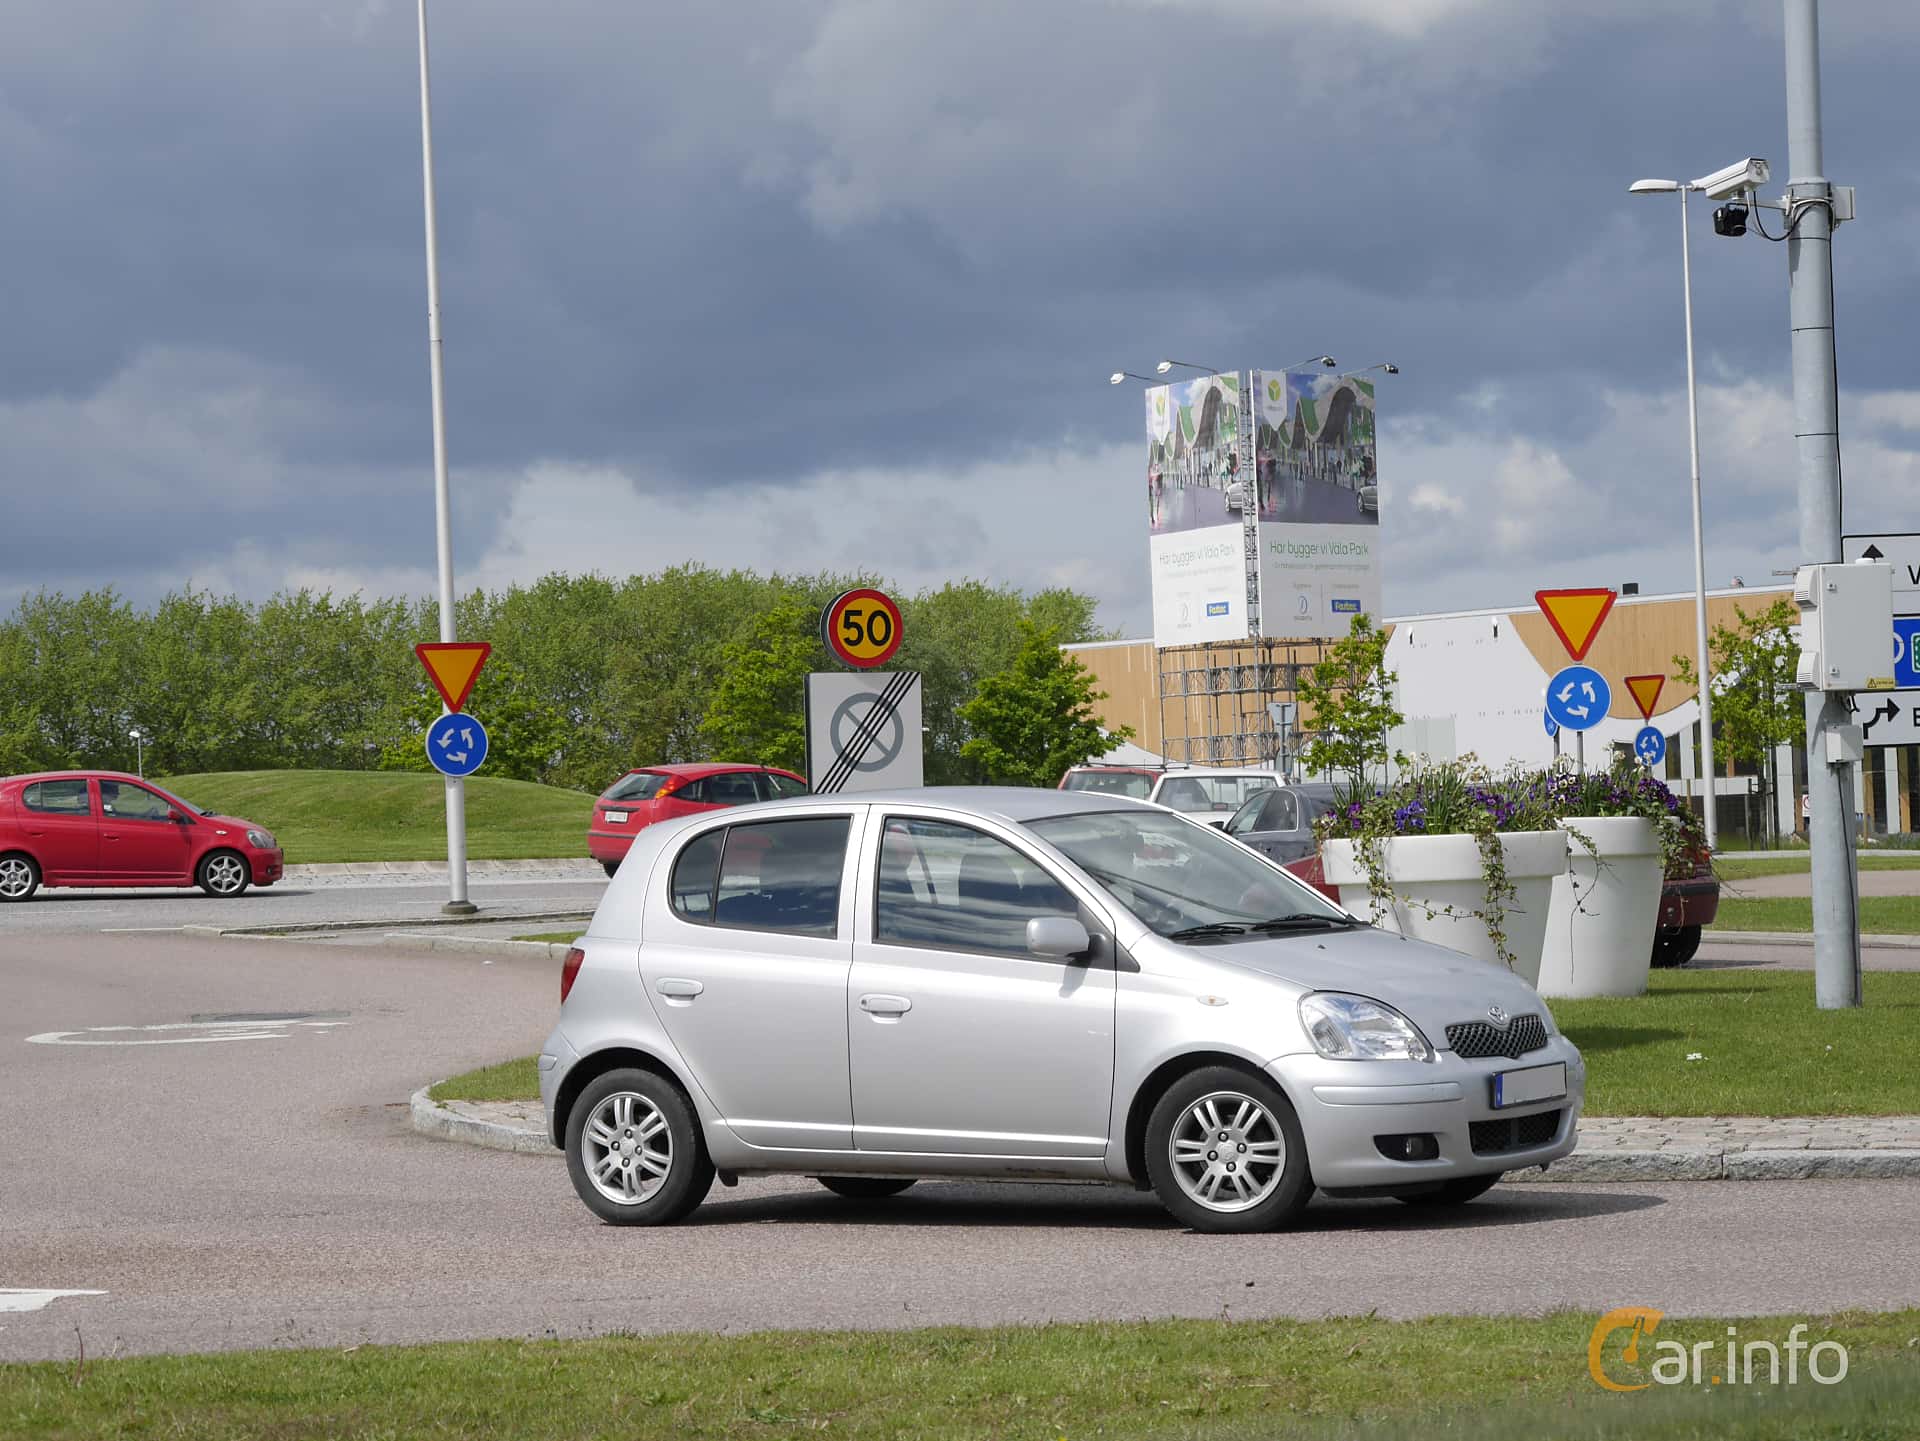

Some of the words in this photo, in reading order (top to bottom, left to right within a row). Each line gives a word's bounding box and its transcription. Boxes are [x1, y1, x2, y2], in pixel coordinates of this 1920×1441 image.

[1288, 539, 1318, 558] bygger
[1349, 542, 1368, 556] Park
[843, 610, 892, 647] 50
